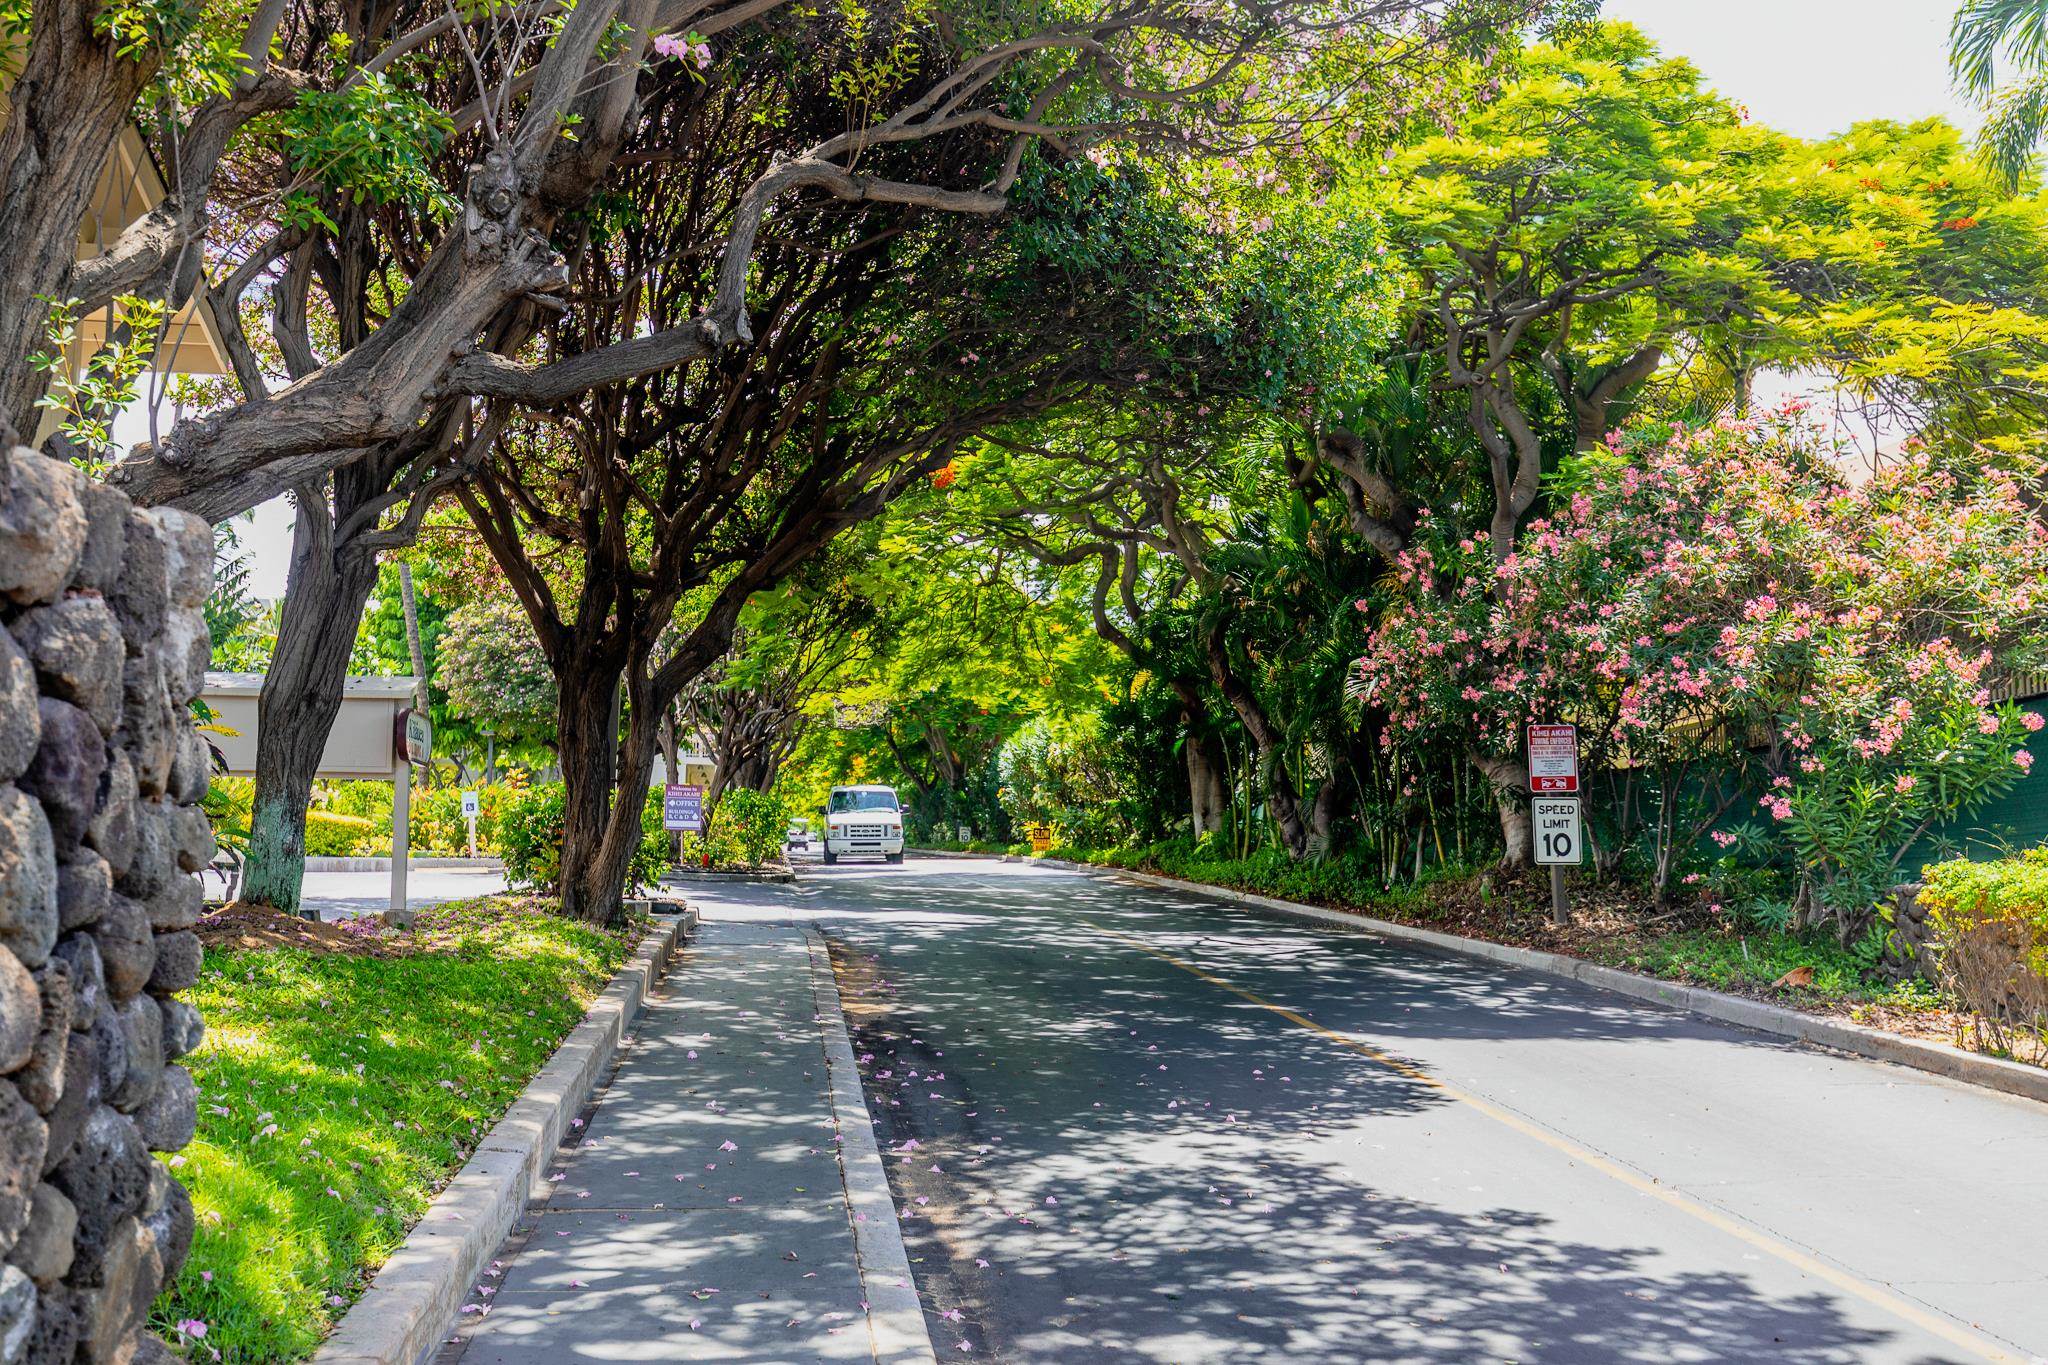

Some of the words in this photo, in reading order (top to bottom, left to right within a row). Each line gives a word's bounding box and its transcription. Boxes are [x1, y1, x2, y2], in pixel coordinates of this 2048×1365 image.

[1539, 805, 1574, 814] SPEED
[1543, 819, 1570, 828] LIMIT
[1035, 830, 1049, 838] SLOW
[1543, 833, 1571, 856] 10
